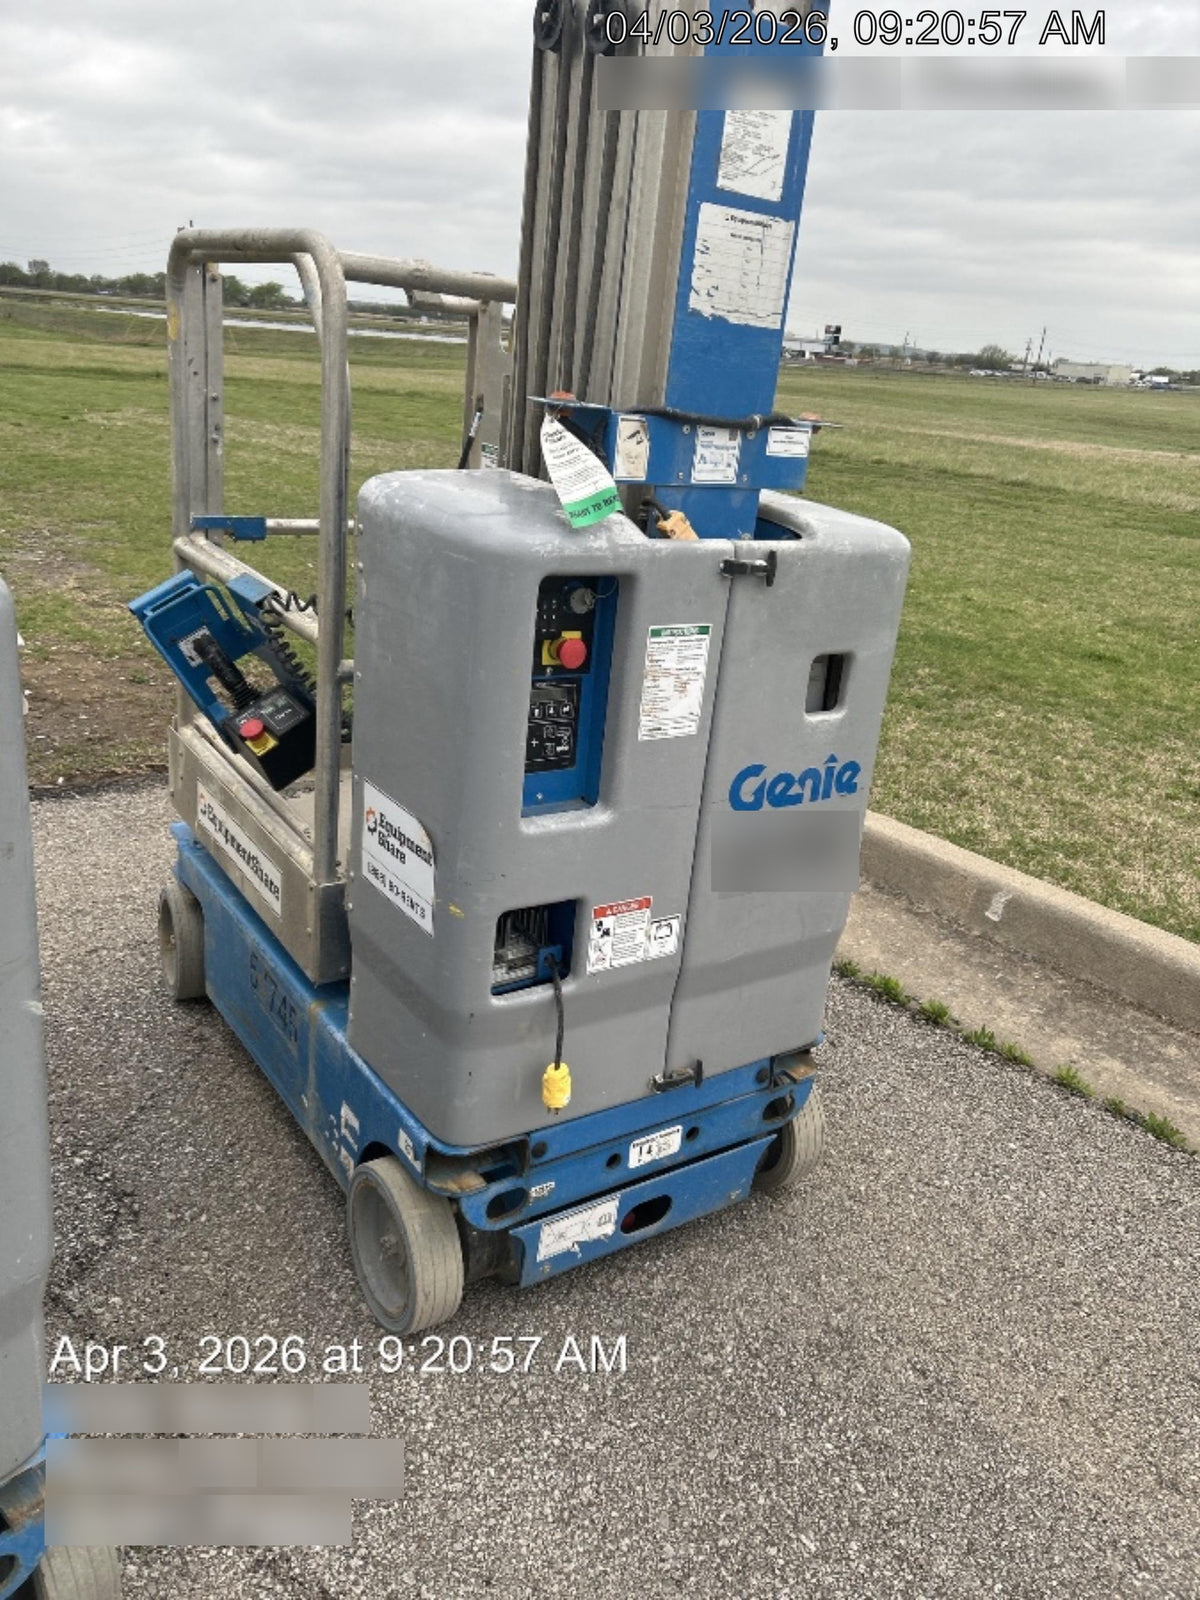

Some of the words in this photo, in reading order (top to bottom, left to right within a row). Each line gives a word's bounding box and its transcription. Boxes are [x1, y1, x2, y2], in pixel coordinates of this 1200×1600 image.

[728, 753, 862, 811] Genie
[378, 811, 433, 868] Equipment
[378, 830, 406, 865] Share
